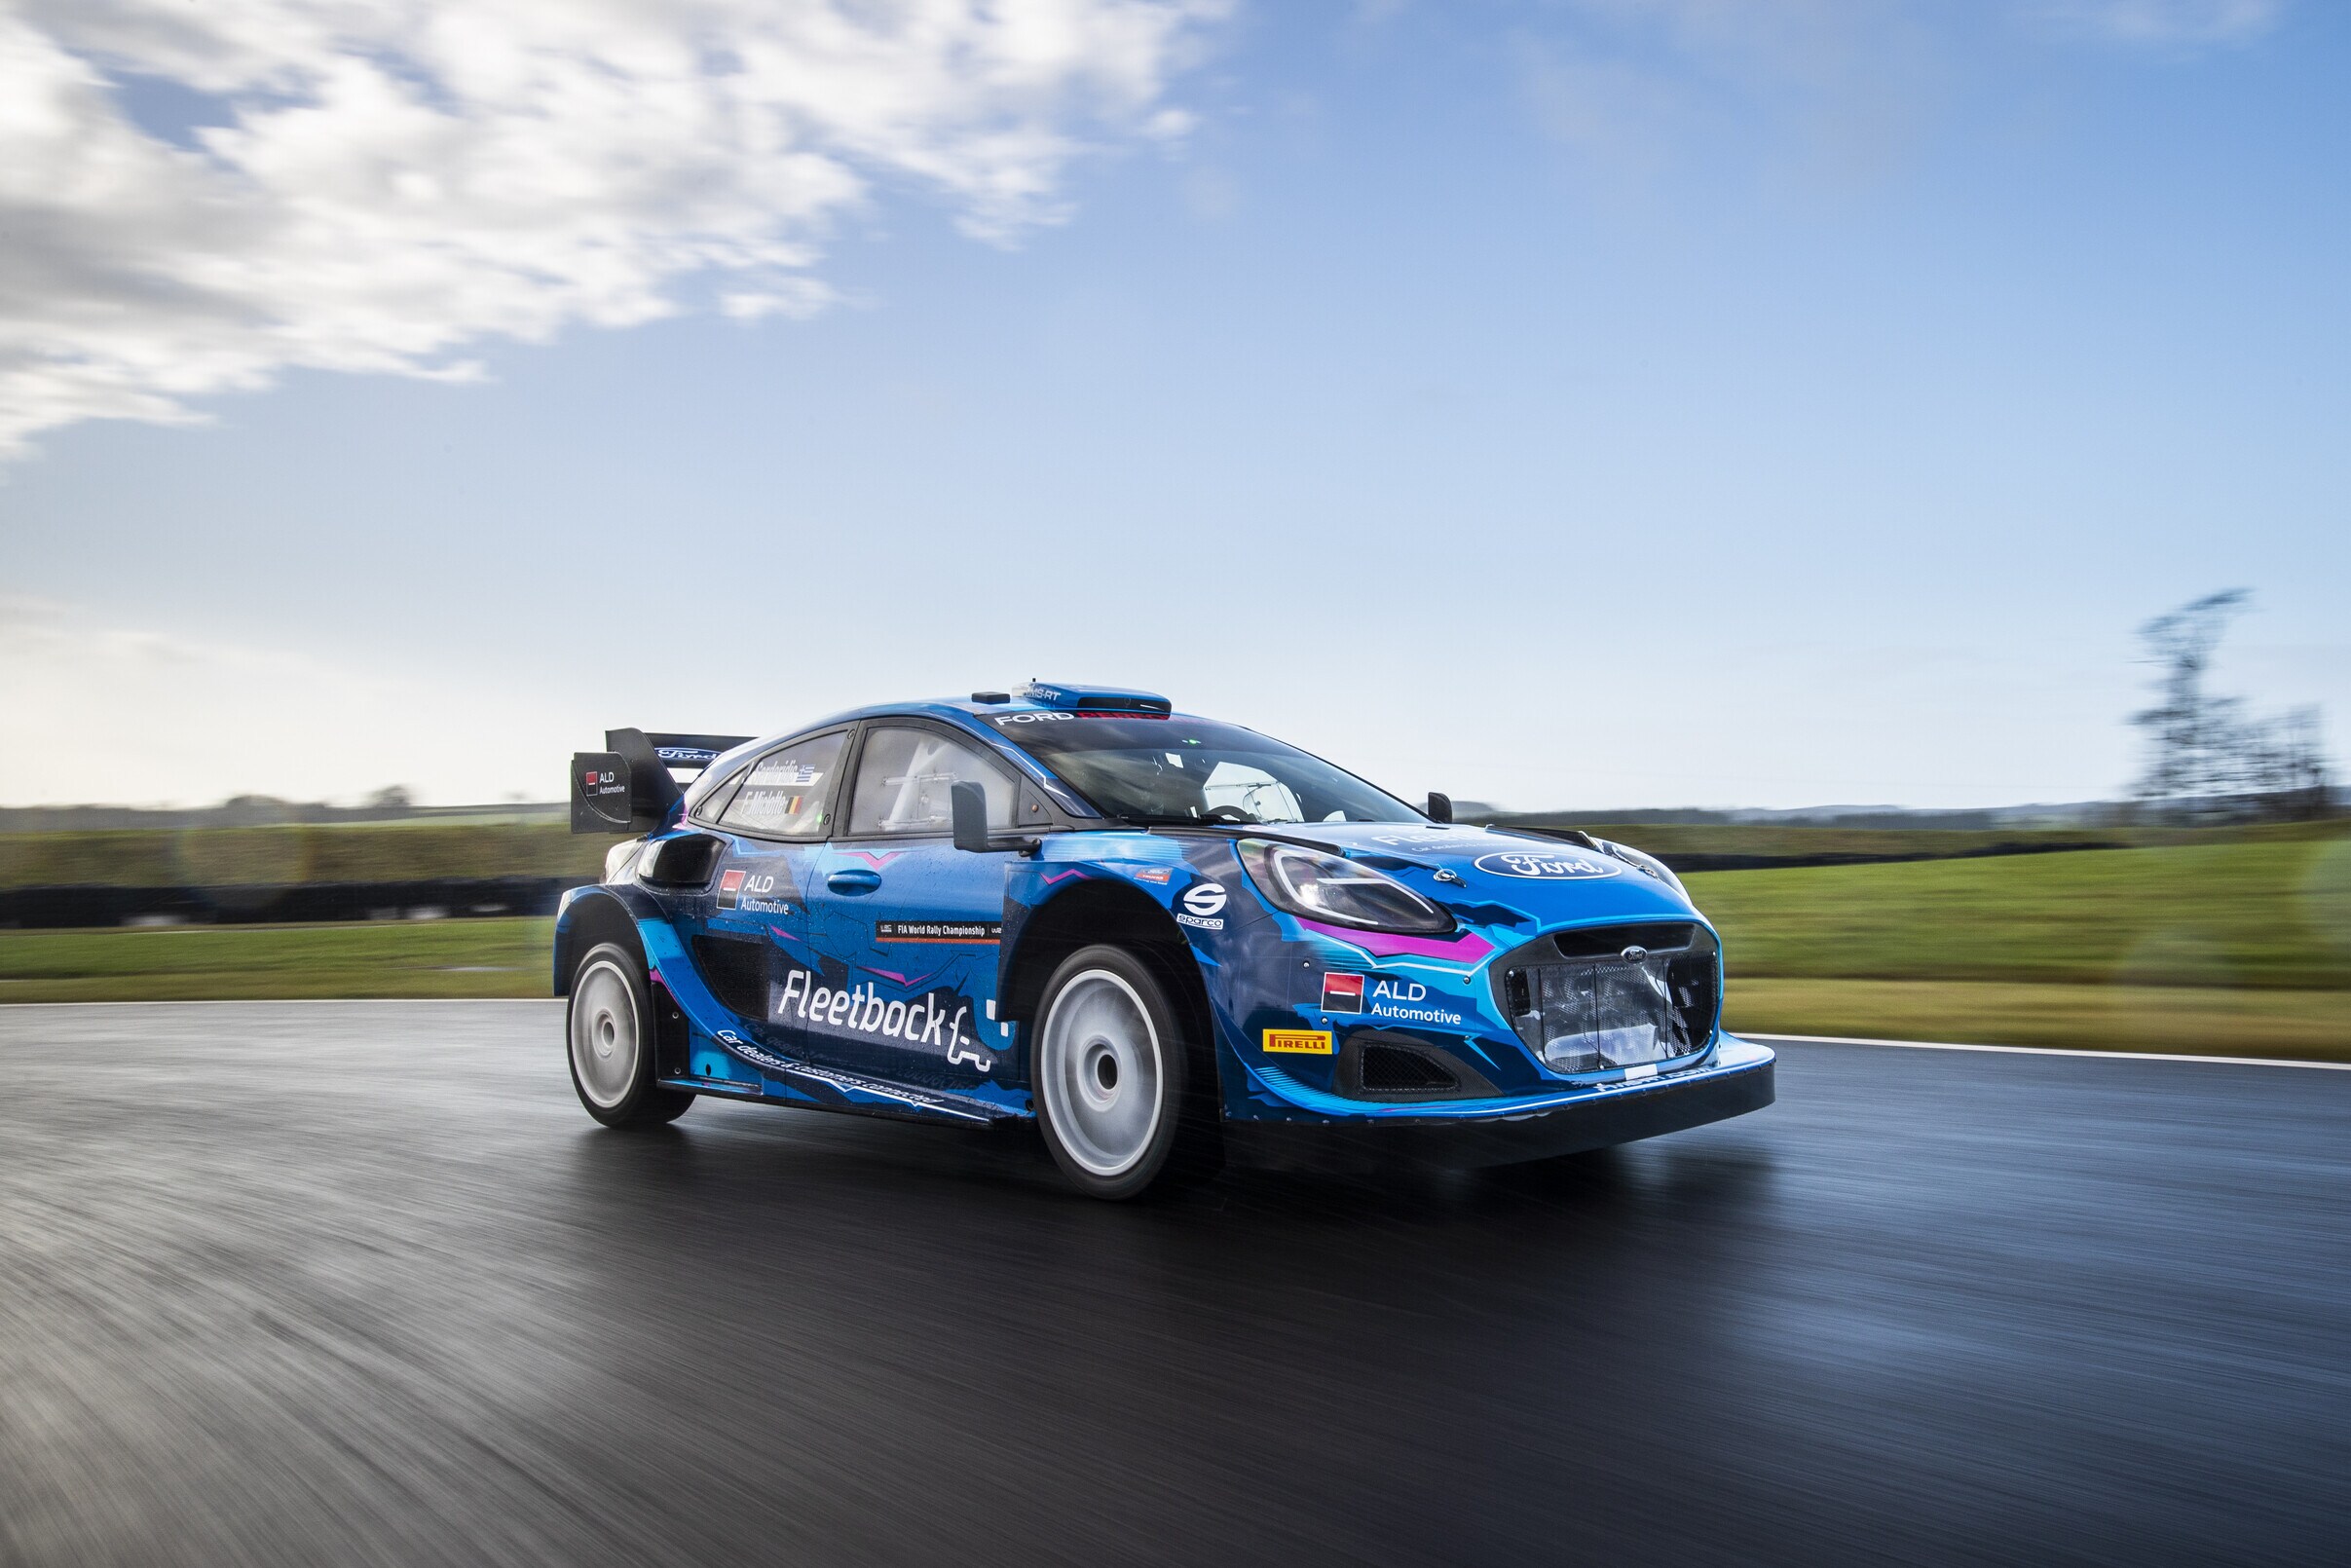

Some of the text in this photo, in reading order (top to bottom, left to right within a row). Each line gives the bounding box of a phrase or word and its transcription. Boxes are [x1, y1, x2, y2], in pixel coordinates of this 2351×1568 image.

[994, 712, 1075, 727] FORD
[599, 771, 615, 783] ALD
[599, 785, 625, 795] Automotive
[1500, 852, 1605, 876] Ford
[743, 875, 774, 893] ALD
[740, 896, 790, 915] Automotive
[1177, 915, 1222, 927] sparco
[897, 924, 986, 937] FIA World Rally Championship
[1372, 980, 1427, 1002] ALD
[778, 969, 947, 1046] Fleetback
[1371, 1002, 1462, 1026] Automotive
[717, 1029, 743, 1045] Car
[1269, 1033, 1326, 1050] PIRELLI
